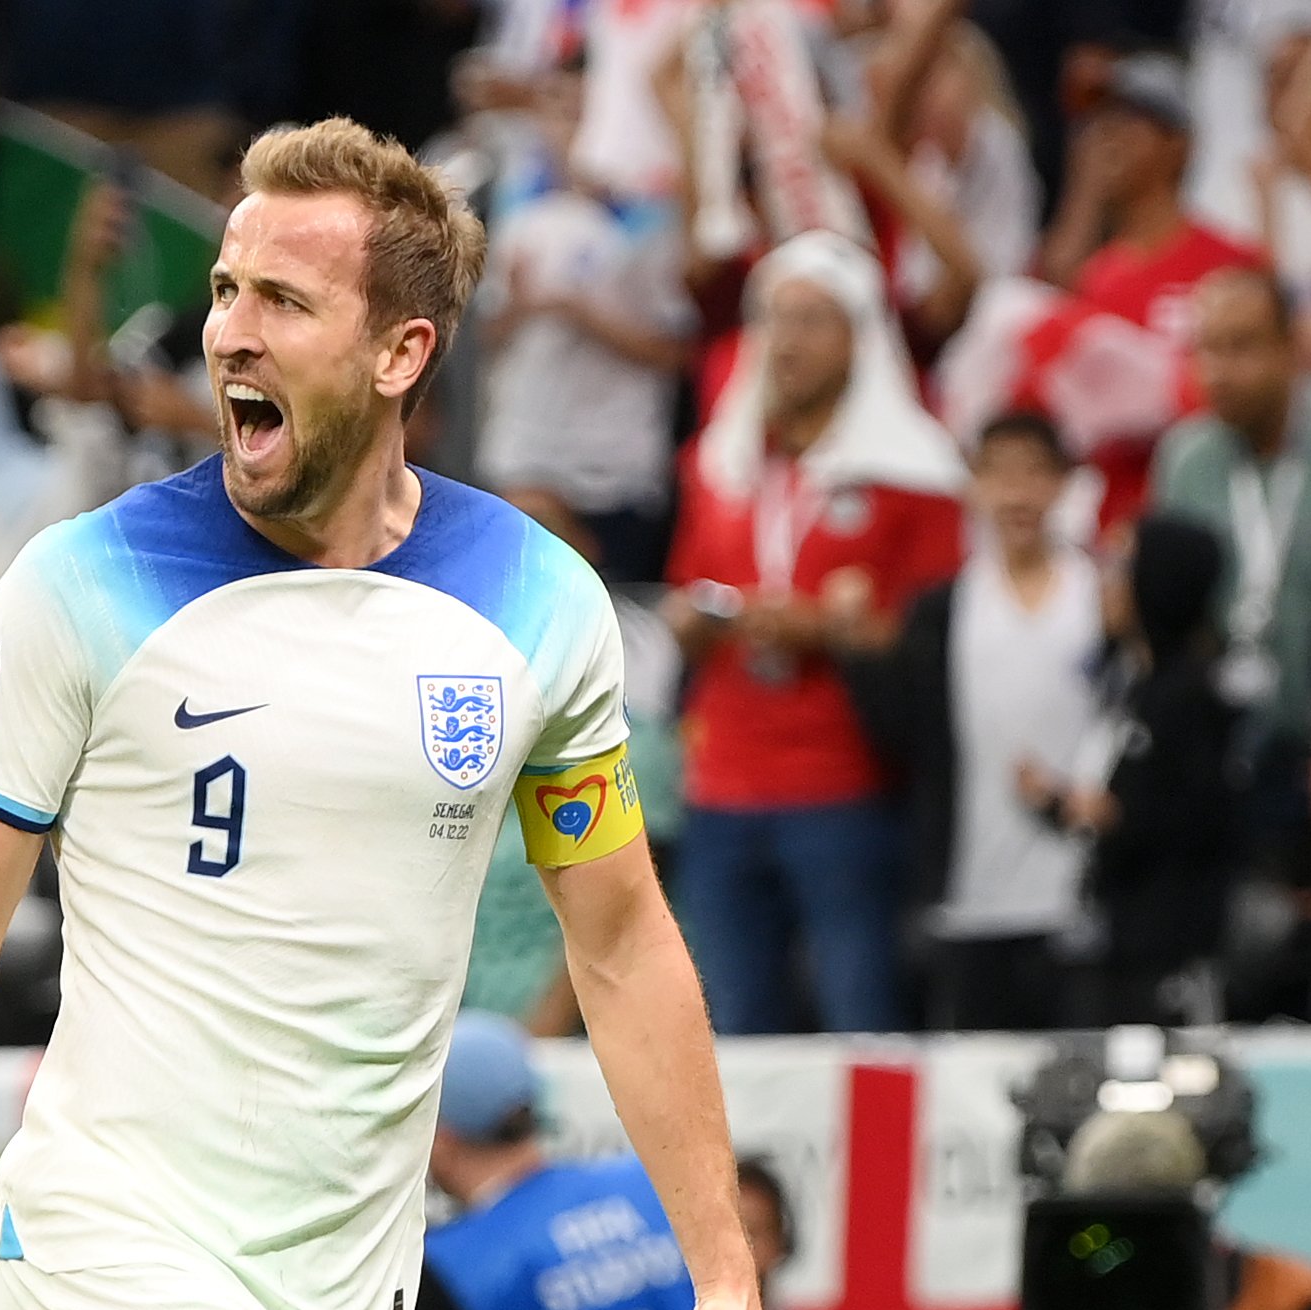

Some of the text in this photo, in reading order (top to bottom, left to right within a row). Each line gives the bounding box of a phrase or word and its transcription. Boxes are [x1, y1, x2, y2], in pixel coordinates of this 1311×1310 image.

[186, 754, 246, 878] 9
[432, 801, 476, 820] SENEGAL
[428, 822, 470, 841] 04.12.22
